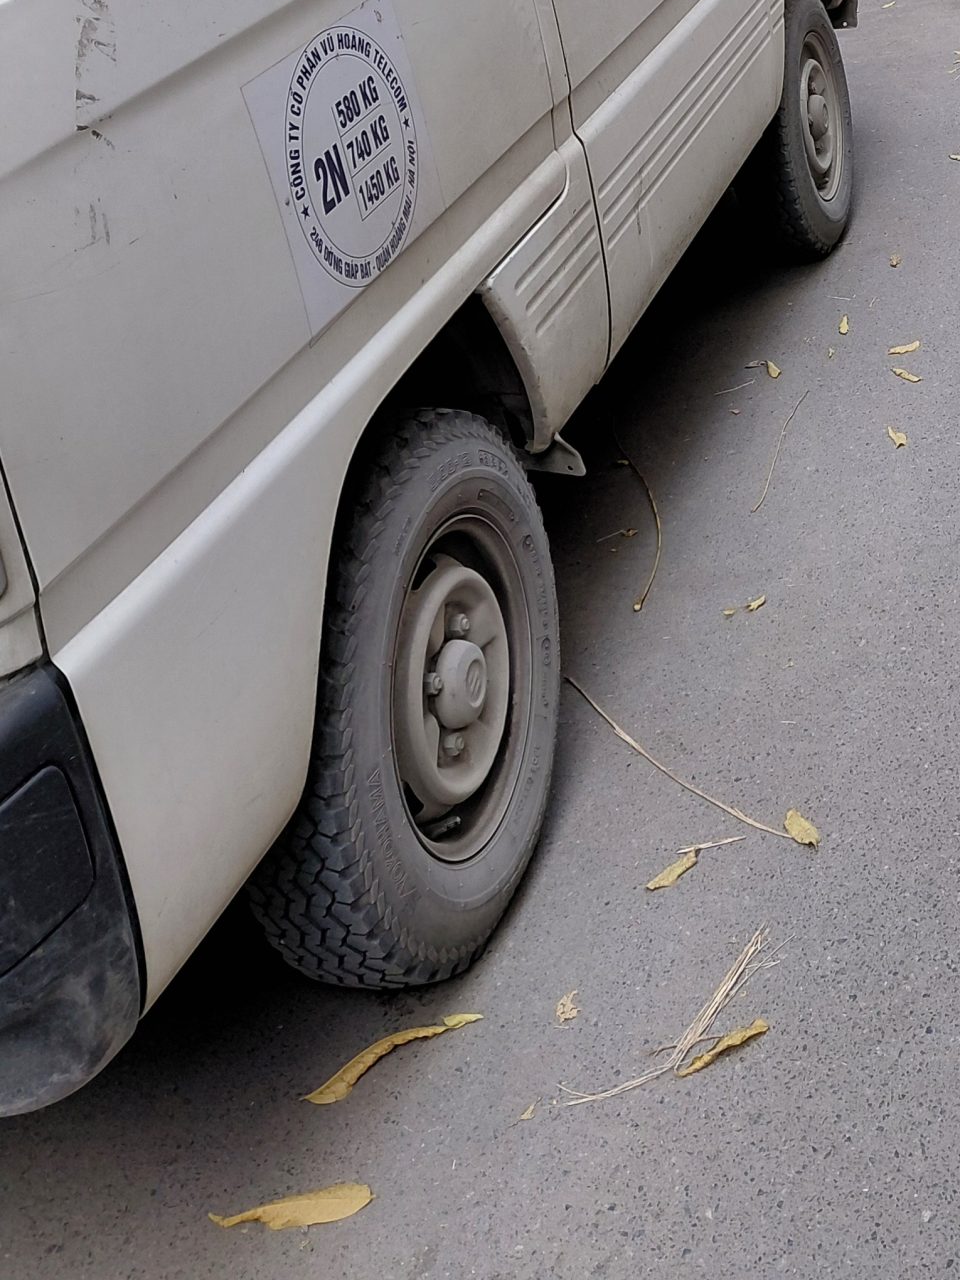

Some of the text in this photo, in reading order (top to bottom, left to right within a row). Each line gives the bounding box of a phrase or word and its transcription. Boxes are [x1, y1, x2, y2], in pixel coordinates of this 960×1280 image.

[319, 32, 335, 56] VŨ
[336, 30, 372, 58] HOÀNG
[335, 75, 379, 129] 580 KG
[373, 48, 408, 113] TELECOM
[289, 121, 301, 142] TY
[346, 114, 390, 169] 740 KG
[289, 149, 306, 201] CÔNG
[313, 143, 350, 215] 2N
[359, 156, 401, 212] 1450 KG
[344, 259, 359, 280] GIÁP
[360, 259, 372, 279] BÁT
[401, 194, 412, 223] MAI
[367, 769, 418, 898] YOKOHAMA
